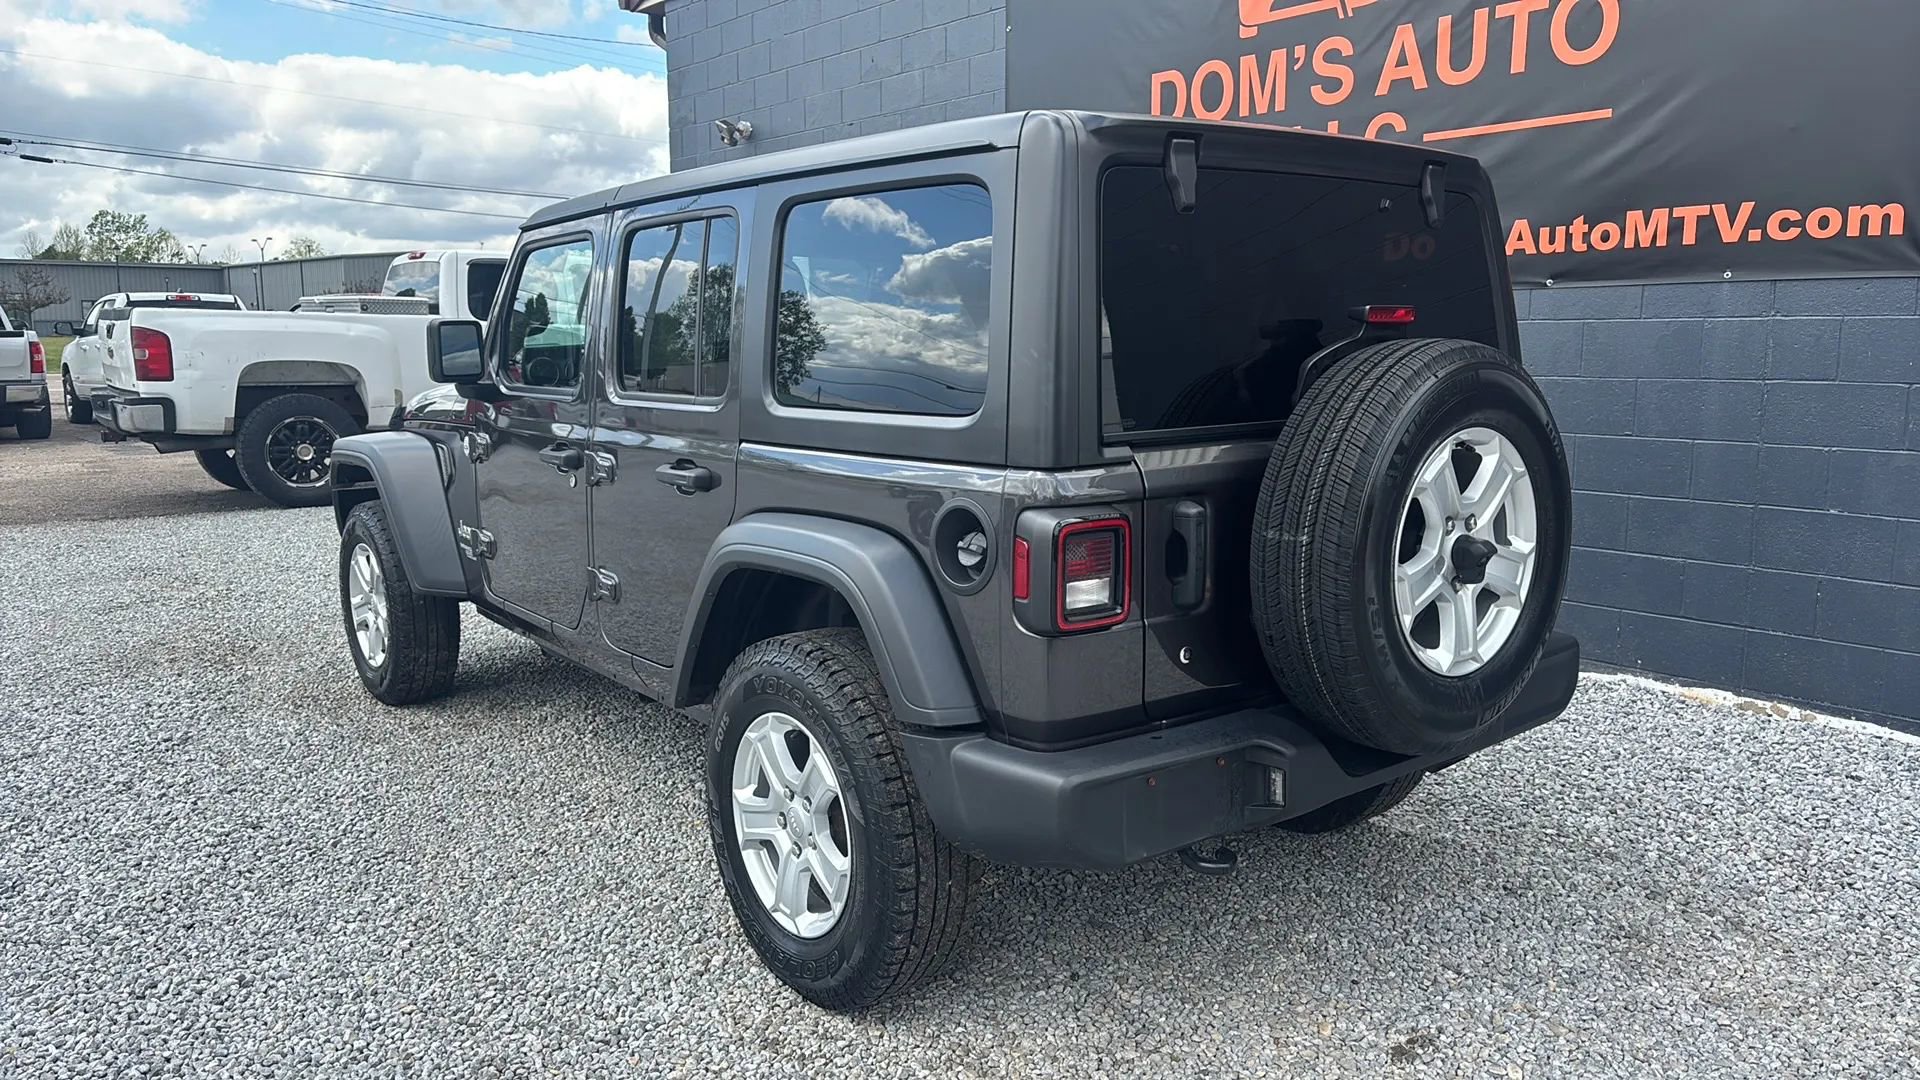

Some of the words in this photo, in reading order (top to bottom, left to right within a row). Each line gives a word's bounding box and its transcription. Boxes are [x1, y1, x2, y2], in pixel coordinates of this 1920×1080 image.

[1151, 36, 1355, 121] DOM'S
[1374, 0, 1620, 97] AUTO
[1505, 201, 1906, 256] AutoMTV.com
[753, 674, 851, 786] YOKOHAMA
